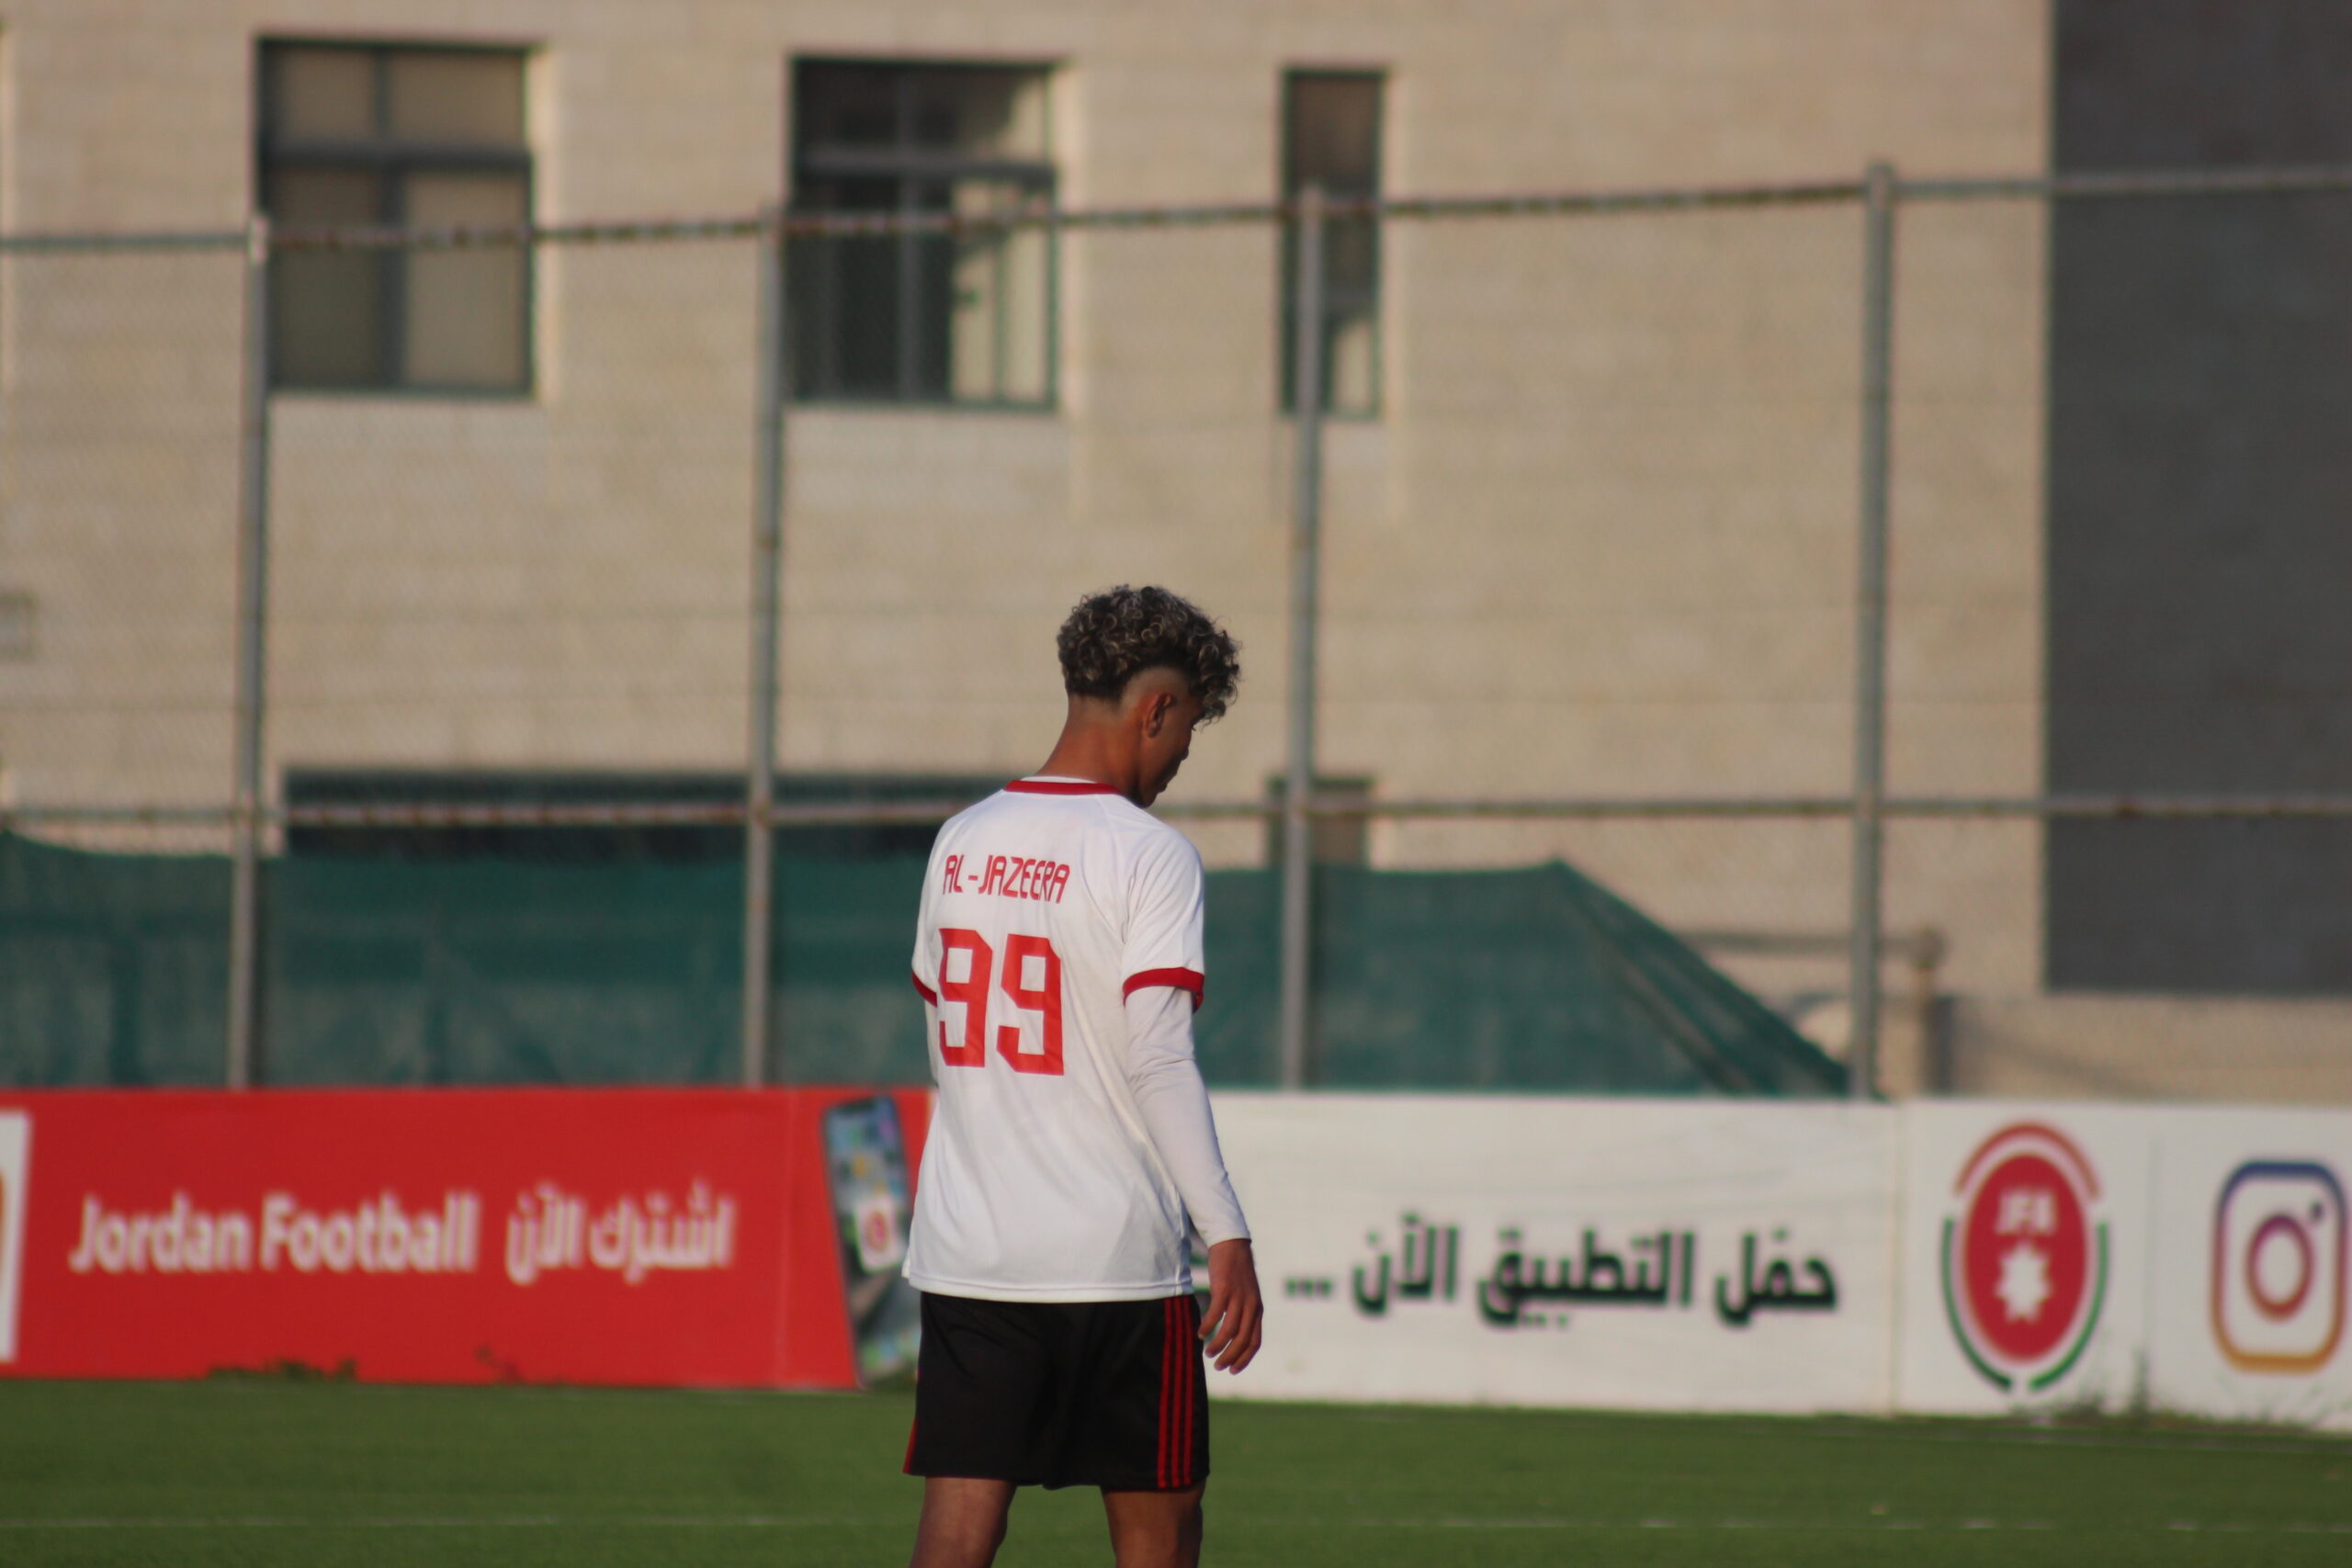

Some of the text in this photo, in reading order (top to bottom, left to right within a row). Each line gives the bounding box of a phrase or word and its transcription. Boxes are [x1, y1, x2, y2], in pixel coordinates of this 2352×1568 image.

[943, 854, 1070, 904] AL-JAZEERA
[938, 928, 1064, 1076] 99
[69, 1192, 479, 1273] Jordan Football
[506, 1178, 736, 1286] اشترك الآن
[1352, 1213, 1459, 1315] الآن
[1476, 1227, 1694, 1326] التطبيق
